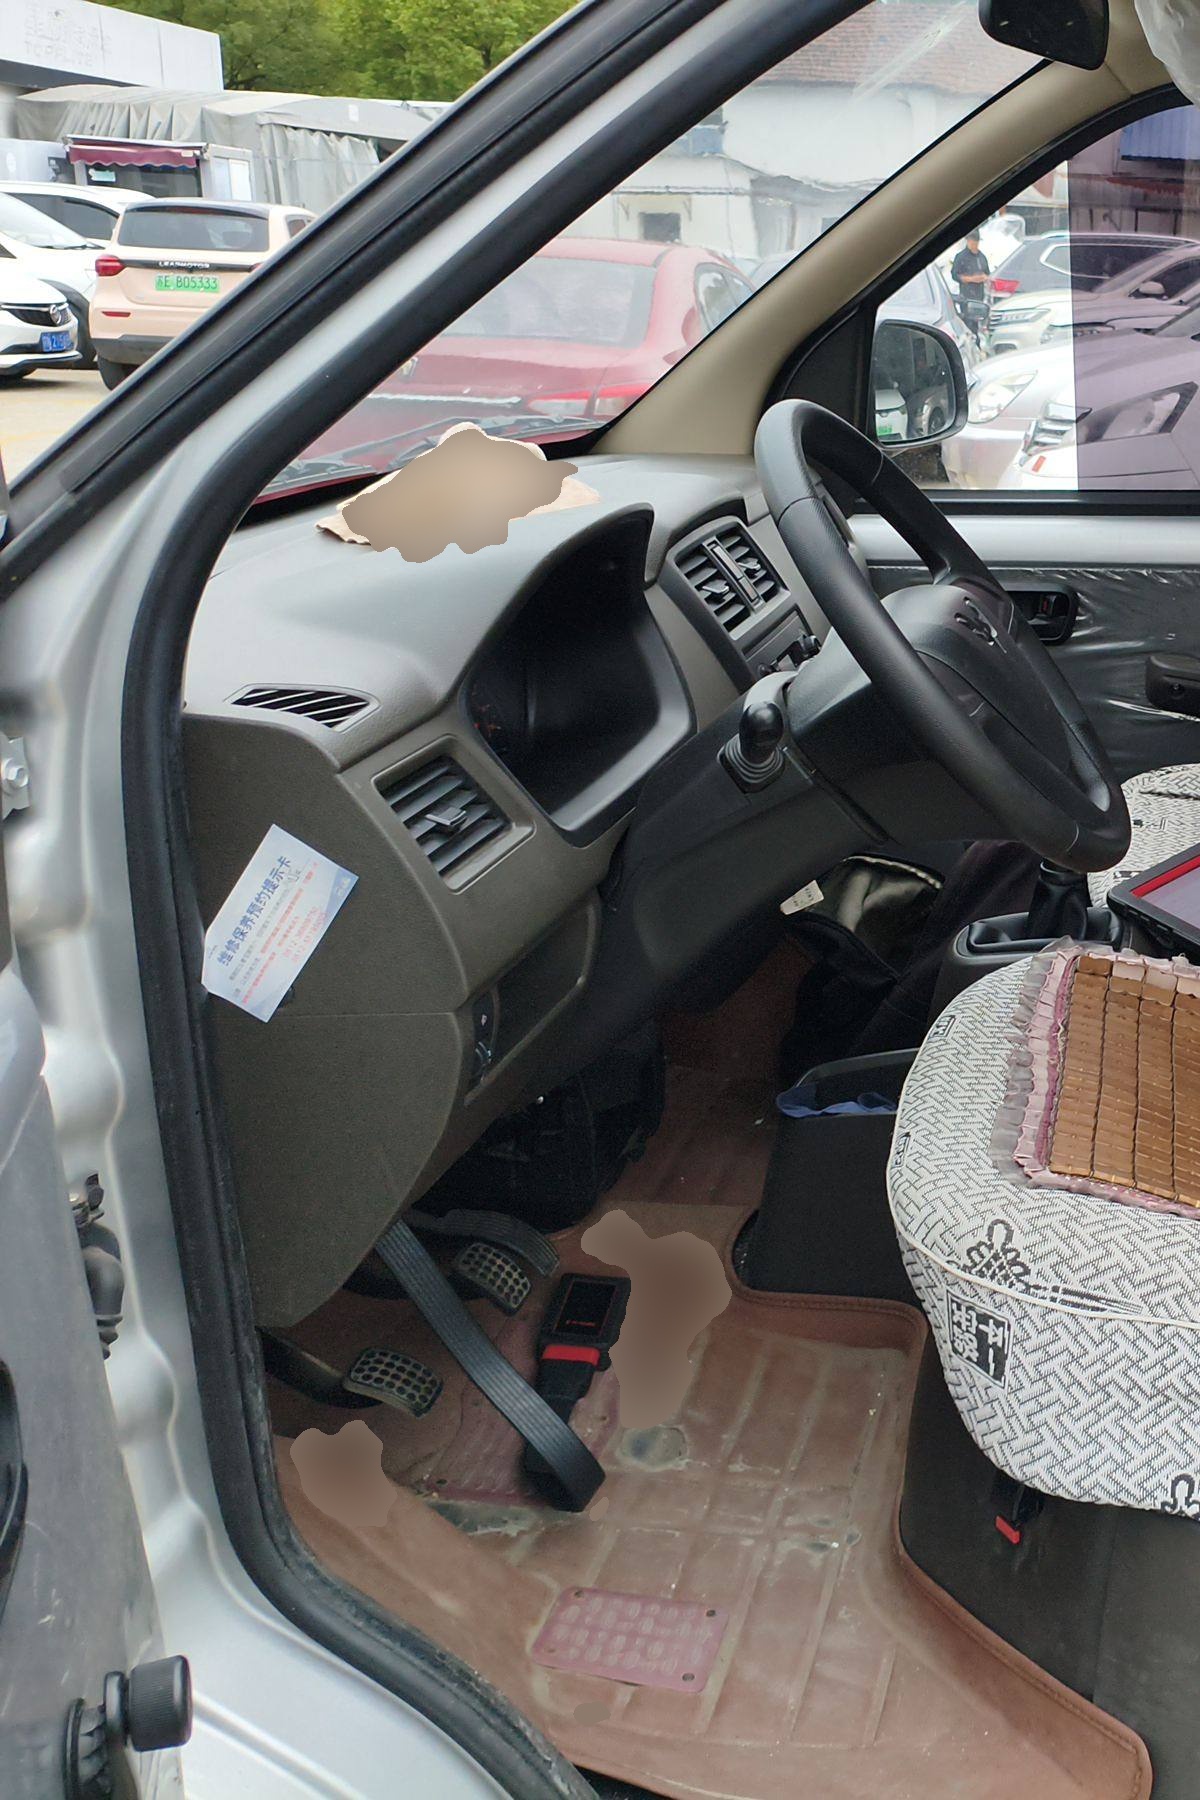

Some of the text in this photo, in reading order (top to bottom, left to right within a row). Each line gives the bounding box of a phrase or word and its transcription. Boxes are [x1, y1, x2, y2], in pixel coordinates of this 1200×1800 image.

[217, 856, 291, 966] 维修保养预约提示卡
